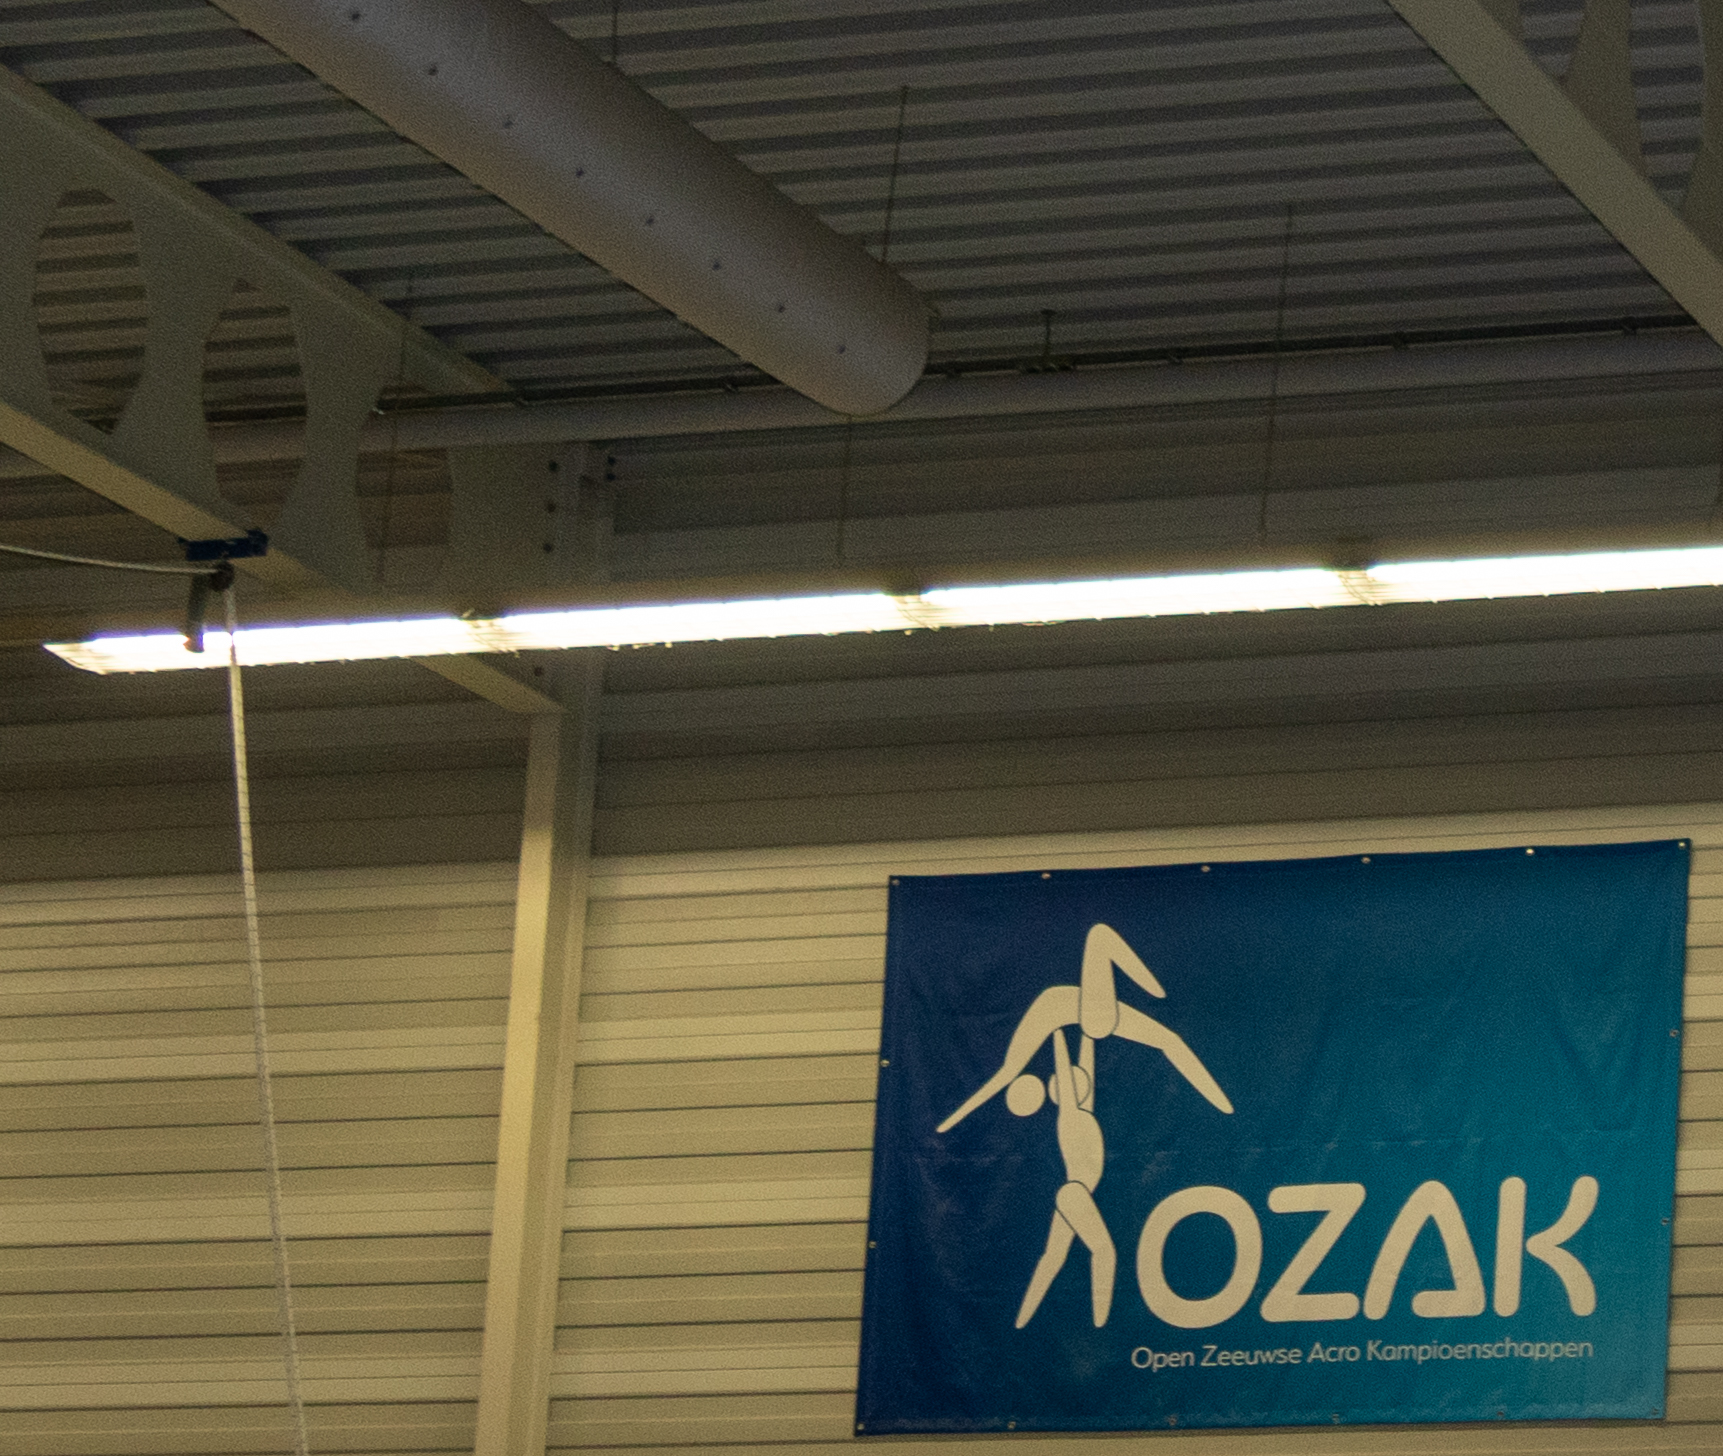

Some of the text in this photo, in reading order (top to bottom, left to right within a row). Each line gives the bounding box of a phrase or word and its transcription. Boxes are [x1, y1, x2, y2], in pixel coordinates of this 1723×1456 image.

[1135, 1174, 1599, 1329] OZAK
[1131, 1337, 1594, 1373] Open Zeeuwse Acro Kampioenschappen
